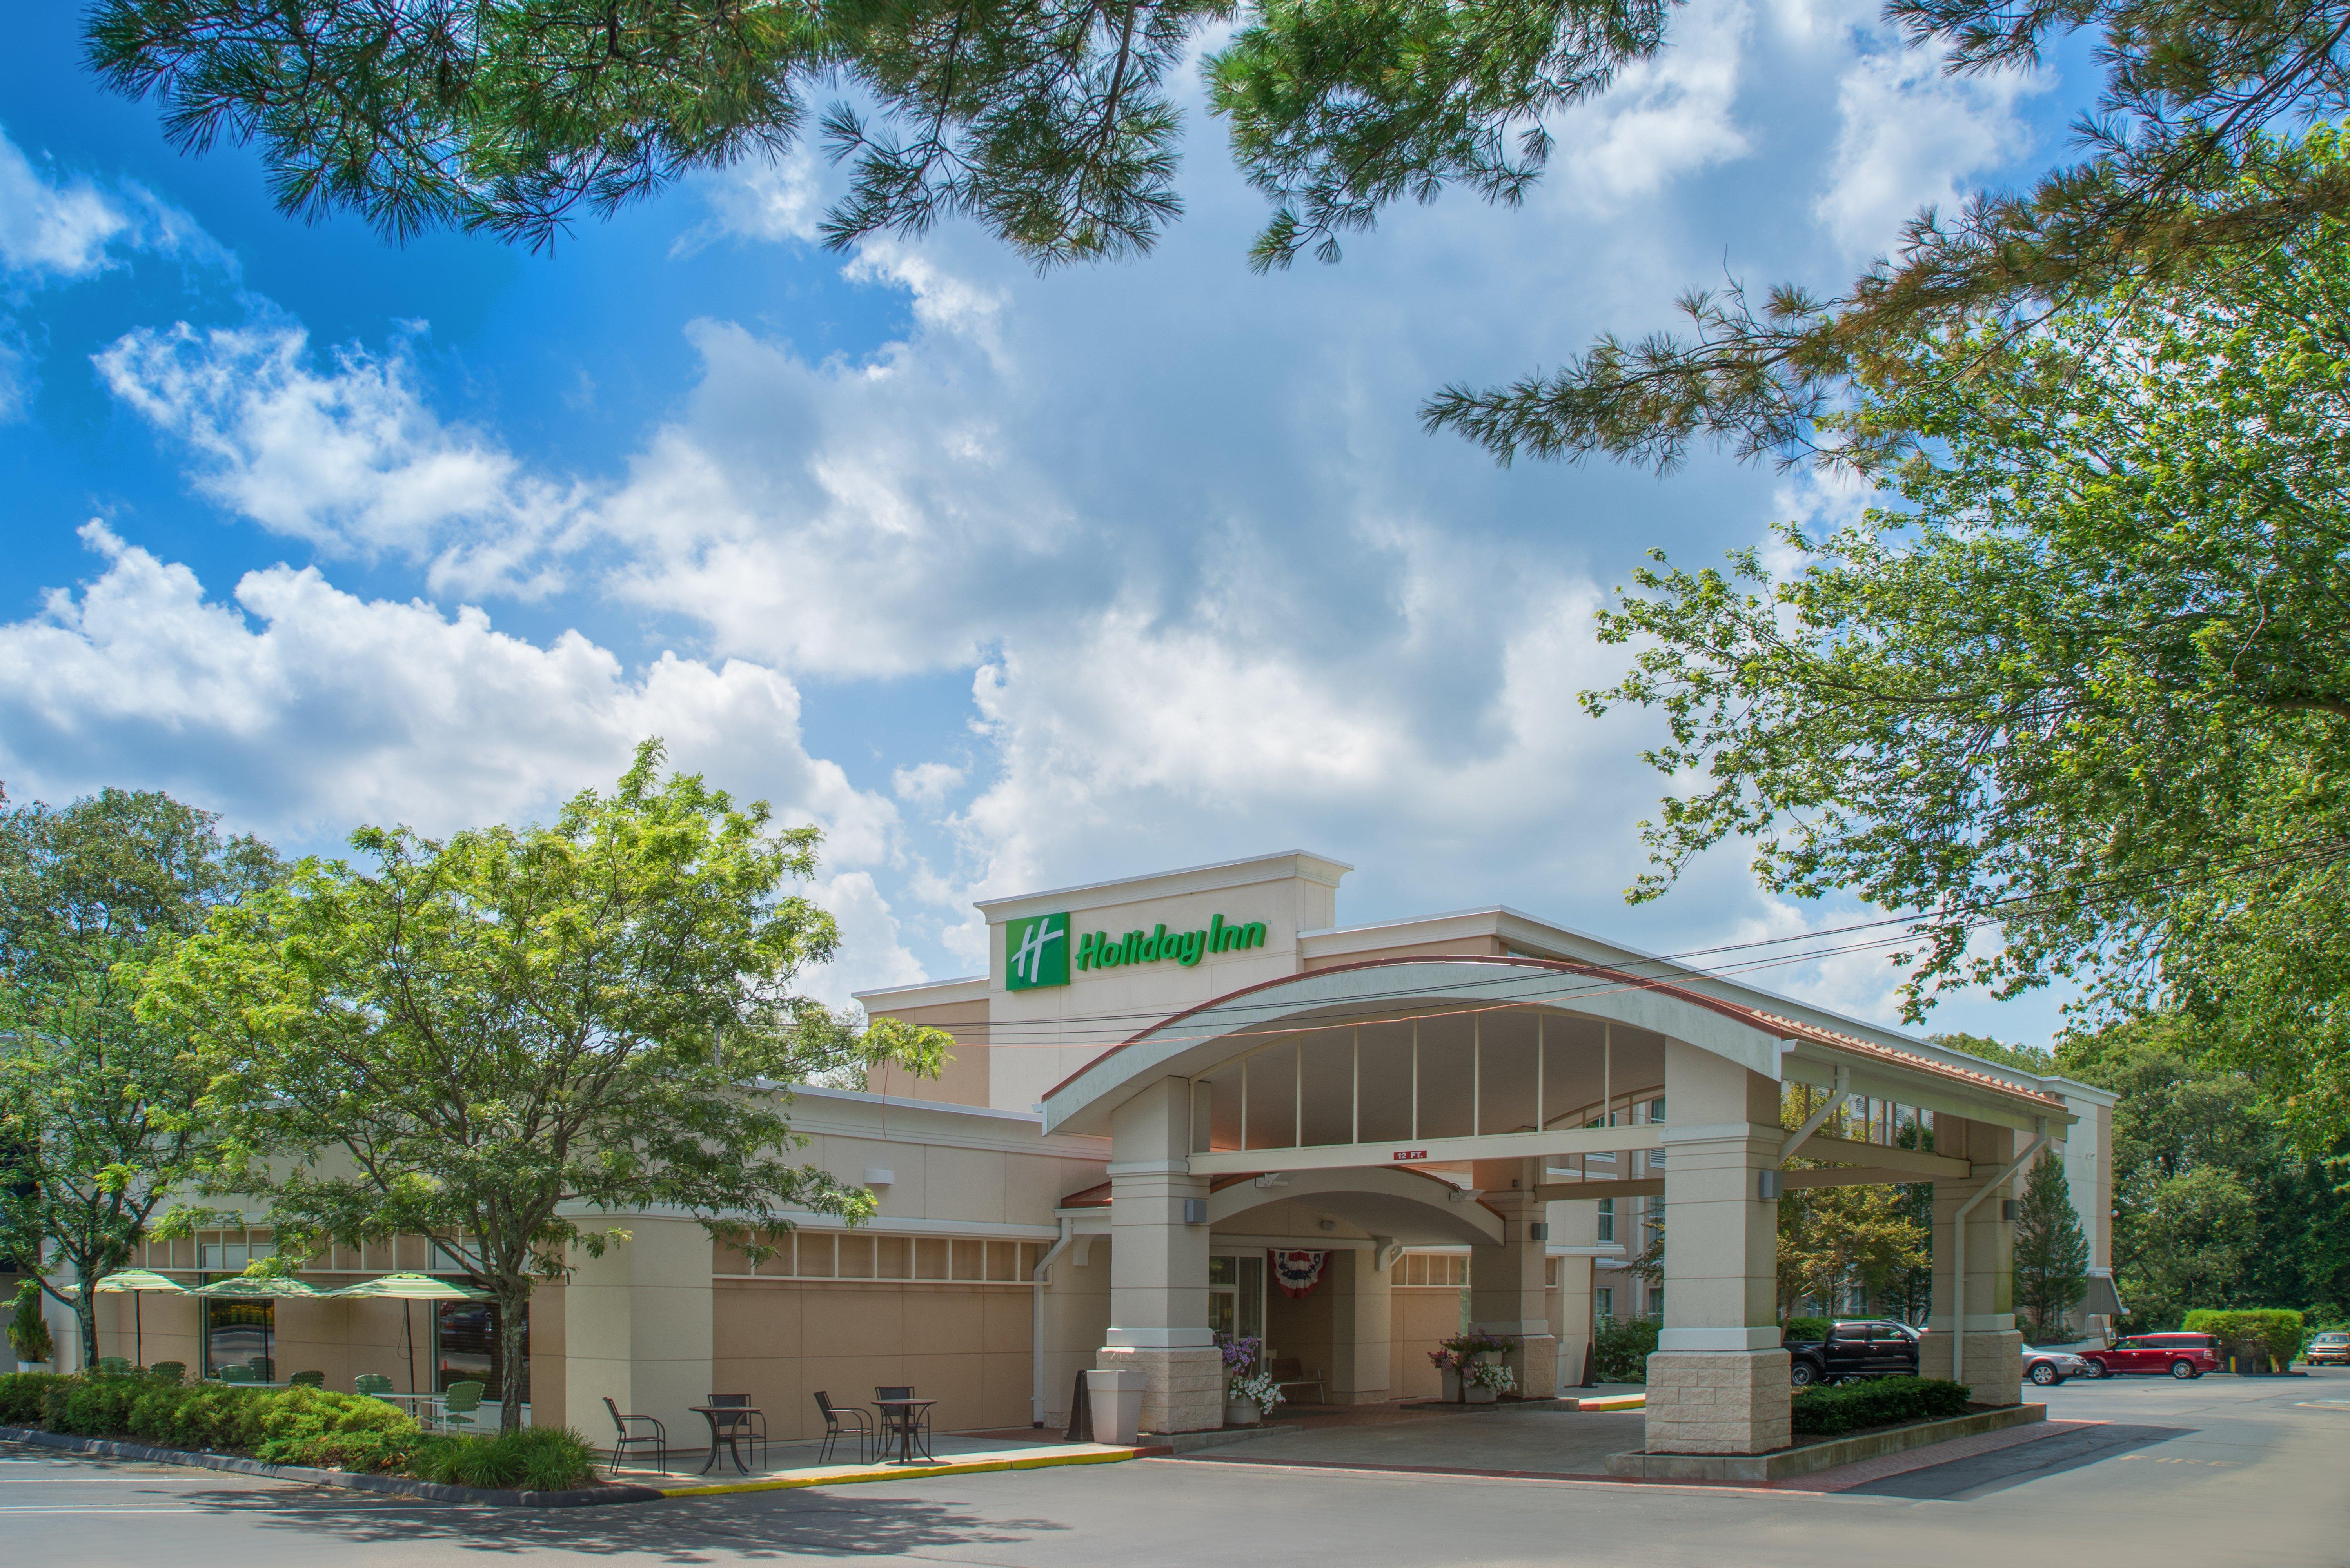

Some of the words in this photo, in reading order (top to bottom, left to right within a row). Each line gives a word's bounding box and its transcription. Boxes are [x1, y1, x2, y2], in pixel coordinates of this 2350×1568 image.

[1075, 923, 1207, 971] Holiday
[1208, 913, 1267, 953] Inn
[2119, 1455, 2243, 1467] FIRE
